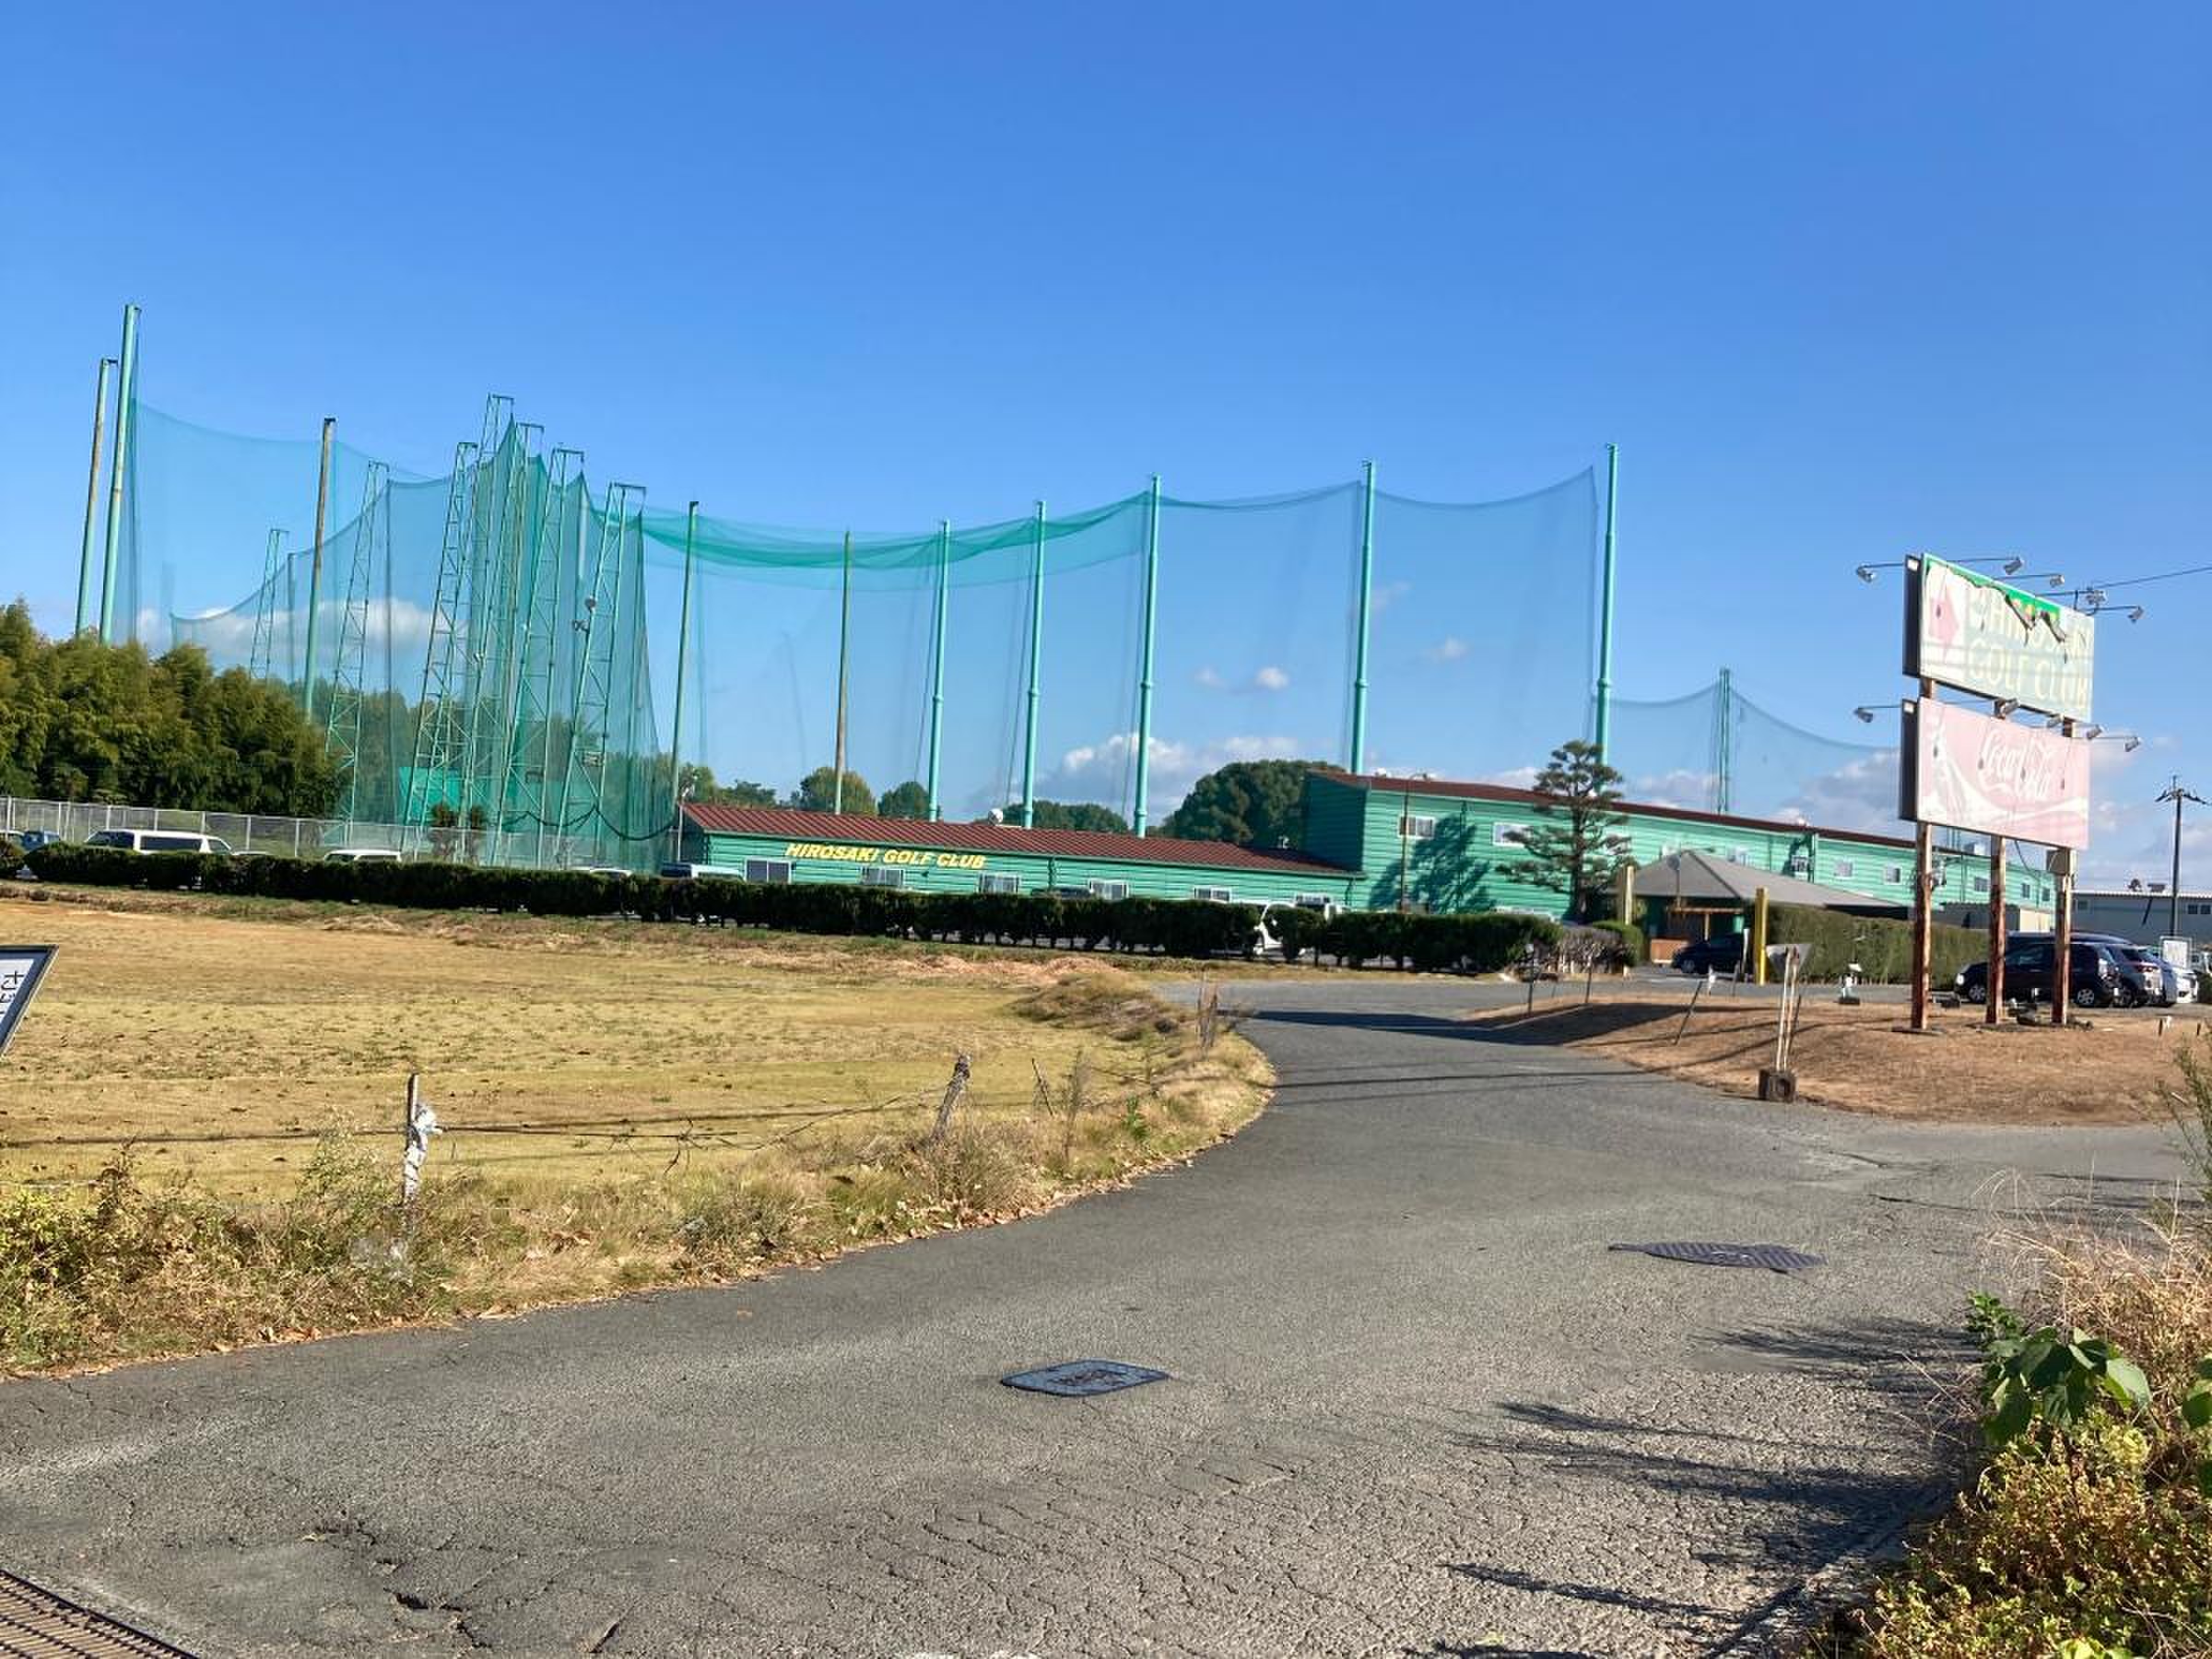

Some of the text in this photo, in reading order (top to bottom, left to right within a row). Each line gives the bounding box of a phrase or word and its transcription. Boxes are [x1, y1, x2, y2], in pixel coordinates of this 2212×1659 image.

[784, 842, 986, 869] HIROSAKI GOLF CLUB
